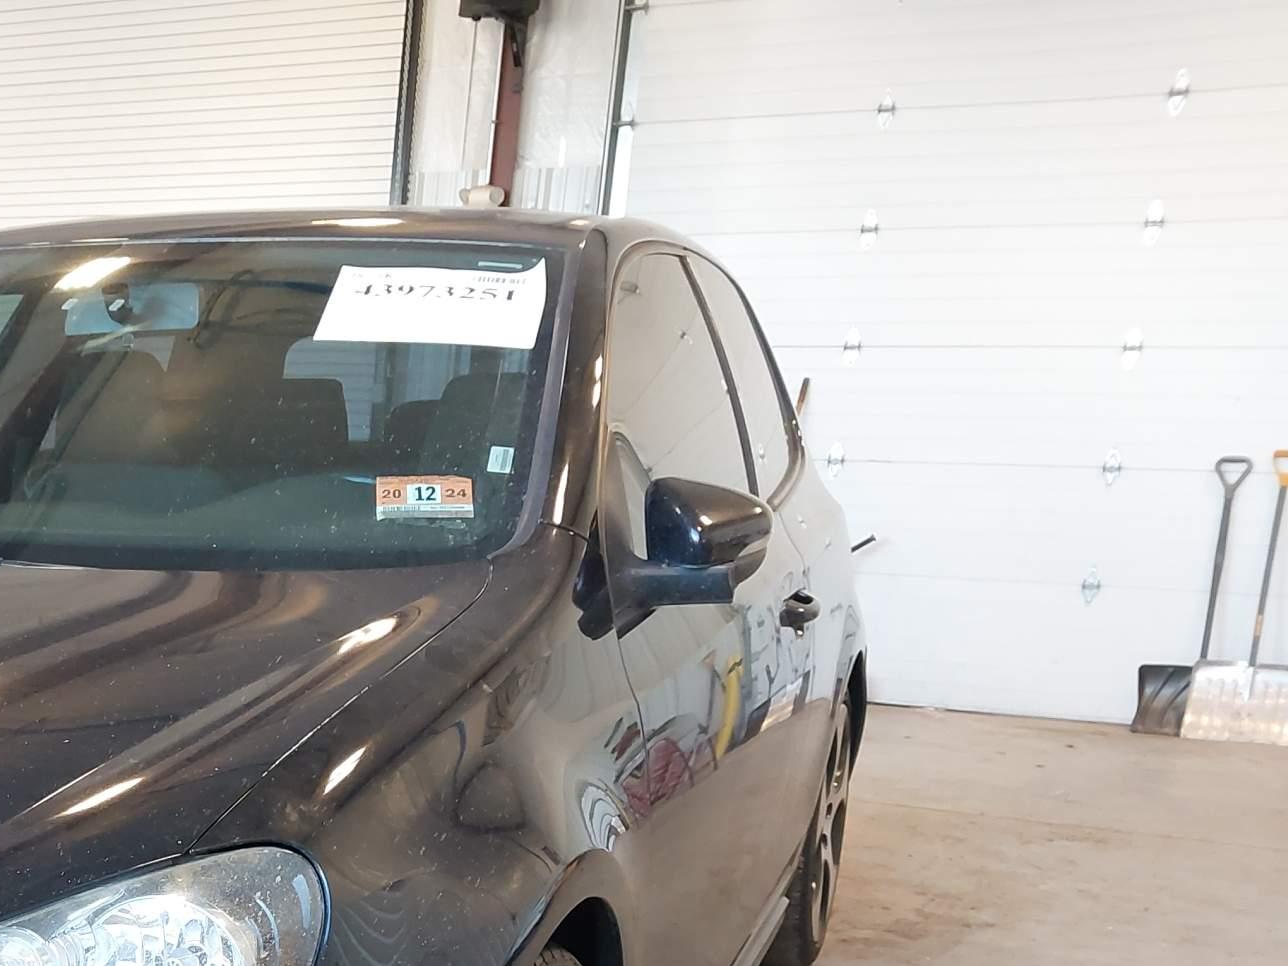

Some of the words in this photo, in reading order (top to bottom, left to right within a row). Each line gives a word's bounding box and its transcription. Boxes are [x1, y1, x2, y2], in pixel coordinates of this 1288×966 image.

[354, 283, 516, 301] 43973251
[381, 489, 402, 499] 20
[414, 486, 437, 502] 12
[445, 488, 467, 499] 24
